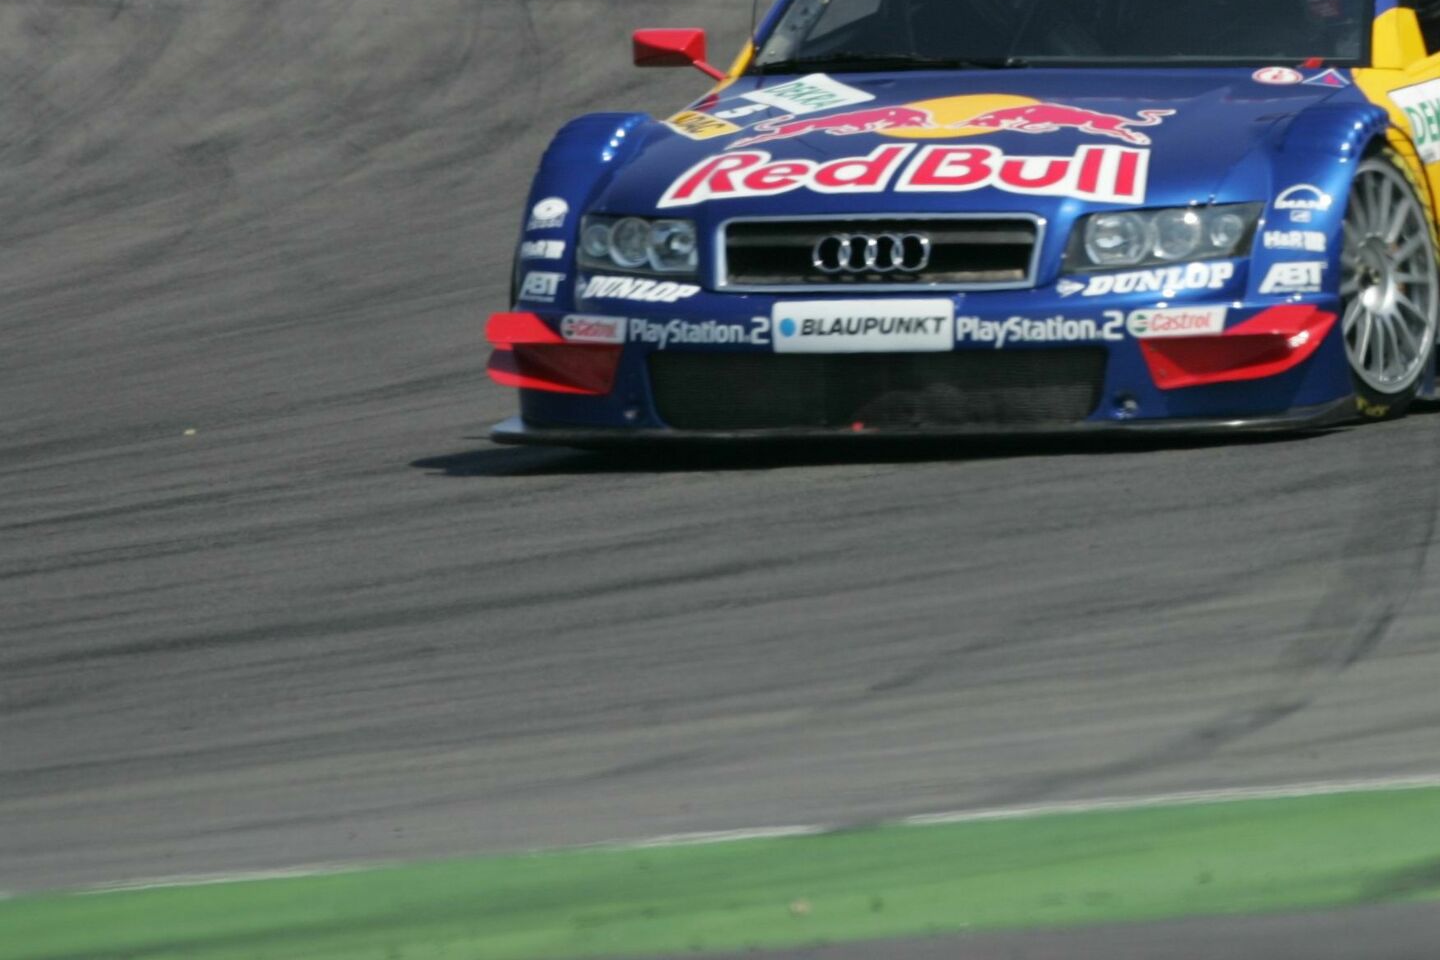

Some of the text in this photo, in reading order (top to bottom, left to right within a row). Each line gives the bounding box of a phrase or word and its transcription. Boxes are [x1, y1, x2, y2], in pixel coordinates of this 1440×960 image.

[658, 143, 1150, 207] Red Bull
[582, 276, 702, 302] DUNLOP
[1082, 262, 1235, 297] DUNLOP
[800, 316, 948, 337] BLAUPUNKT
[956, 315, 1096, 349] PlayStation
[1149, 313, 1213, 333] Castrol
